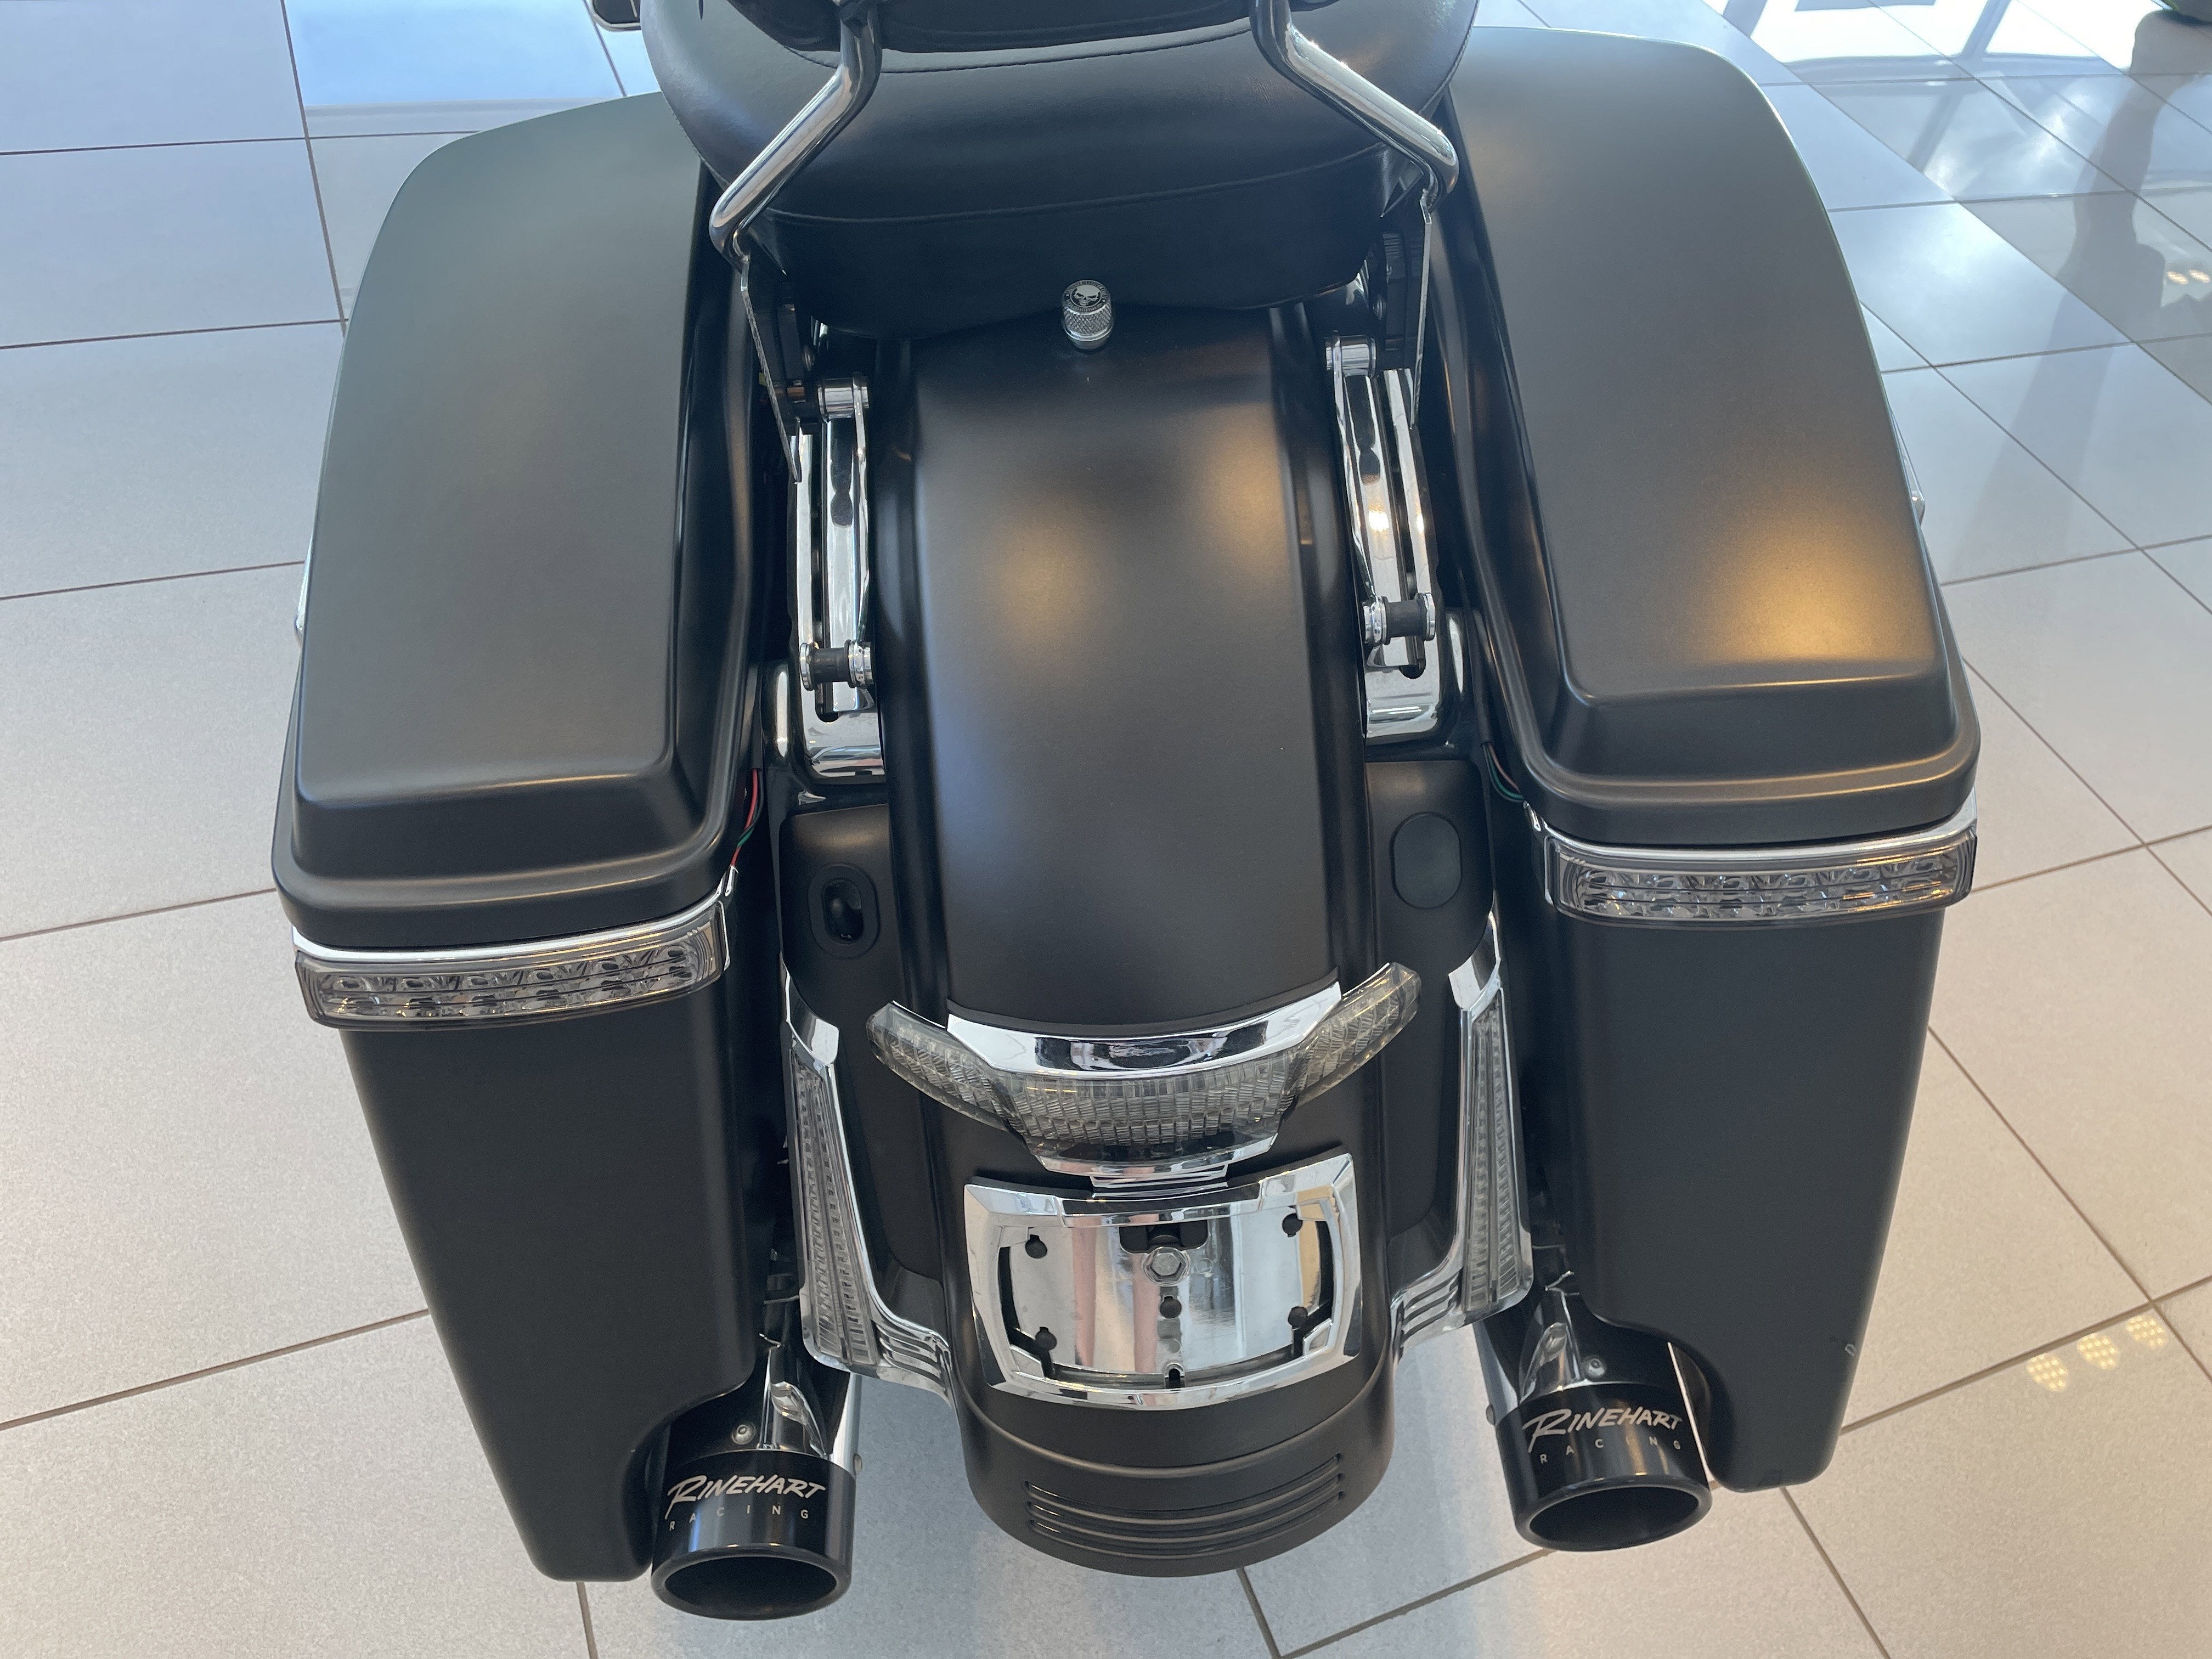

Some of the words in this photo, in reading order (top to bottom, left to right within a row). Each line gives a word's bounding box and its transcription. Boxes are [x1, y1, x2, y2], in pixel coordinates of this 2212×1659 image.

[1522, 1406, 1683, 1453] RINEHART
[665, 1474, 826, 1520] RINEHART
[669, 1504, 809, 1531] RACING
